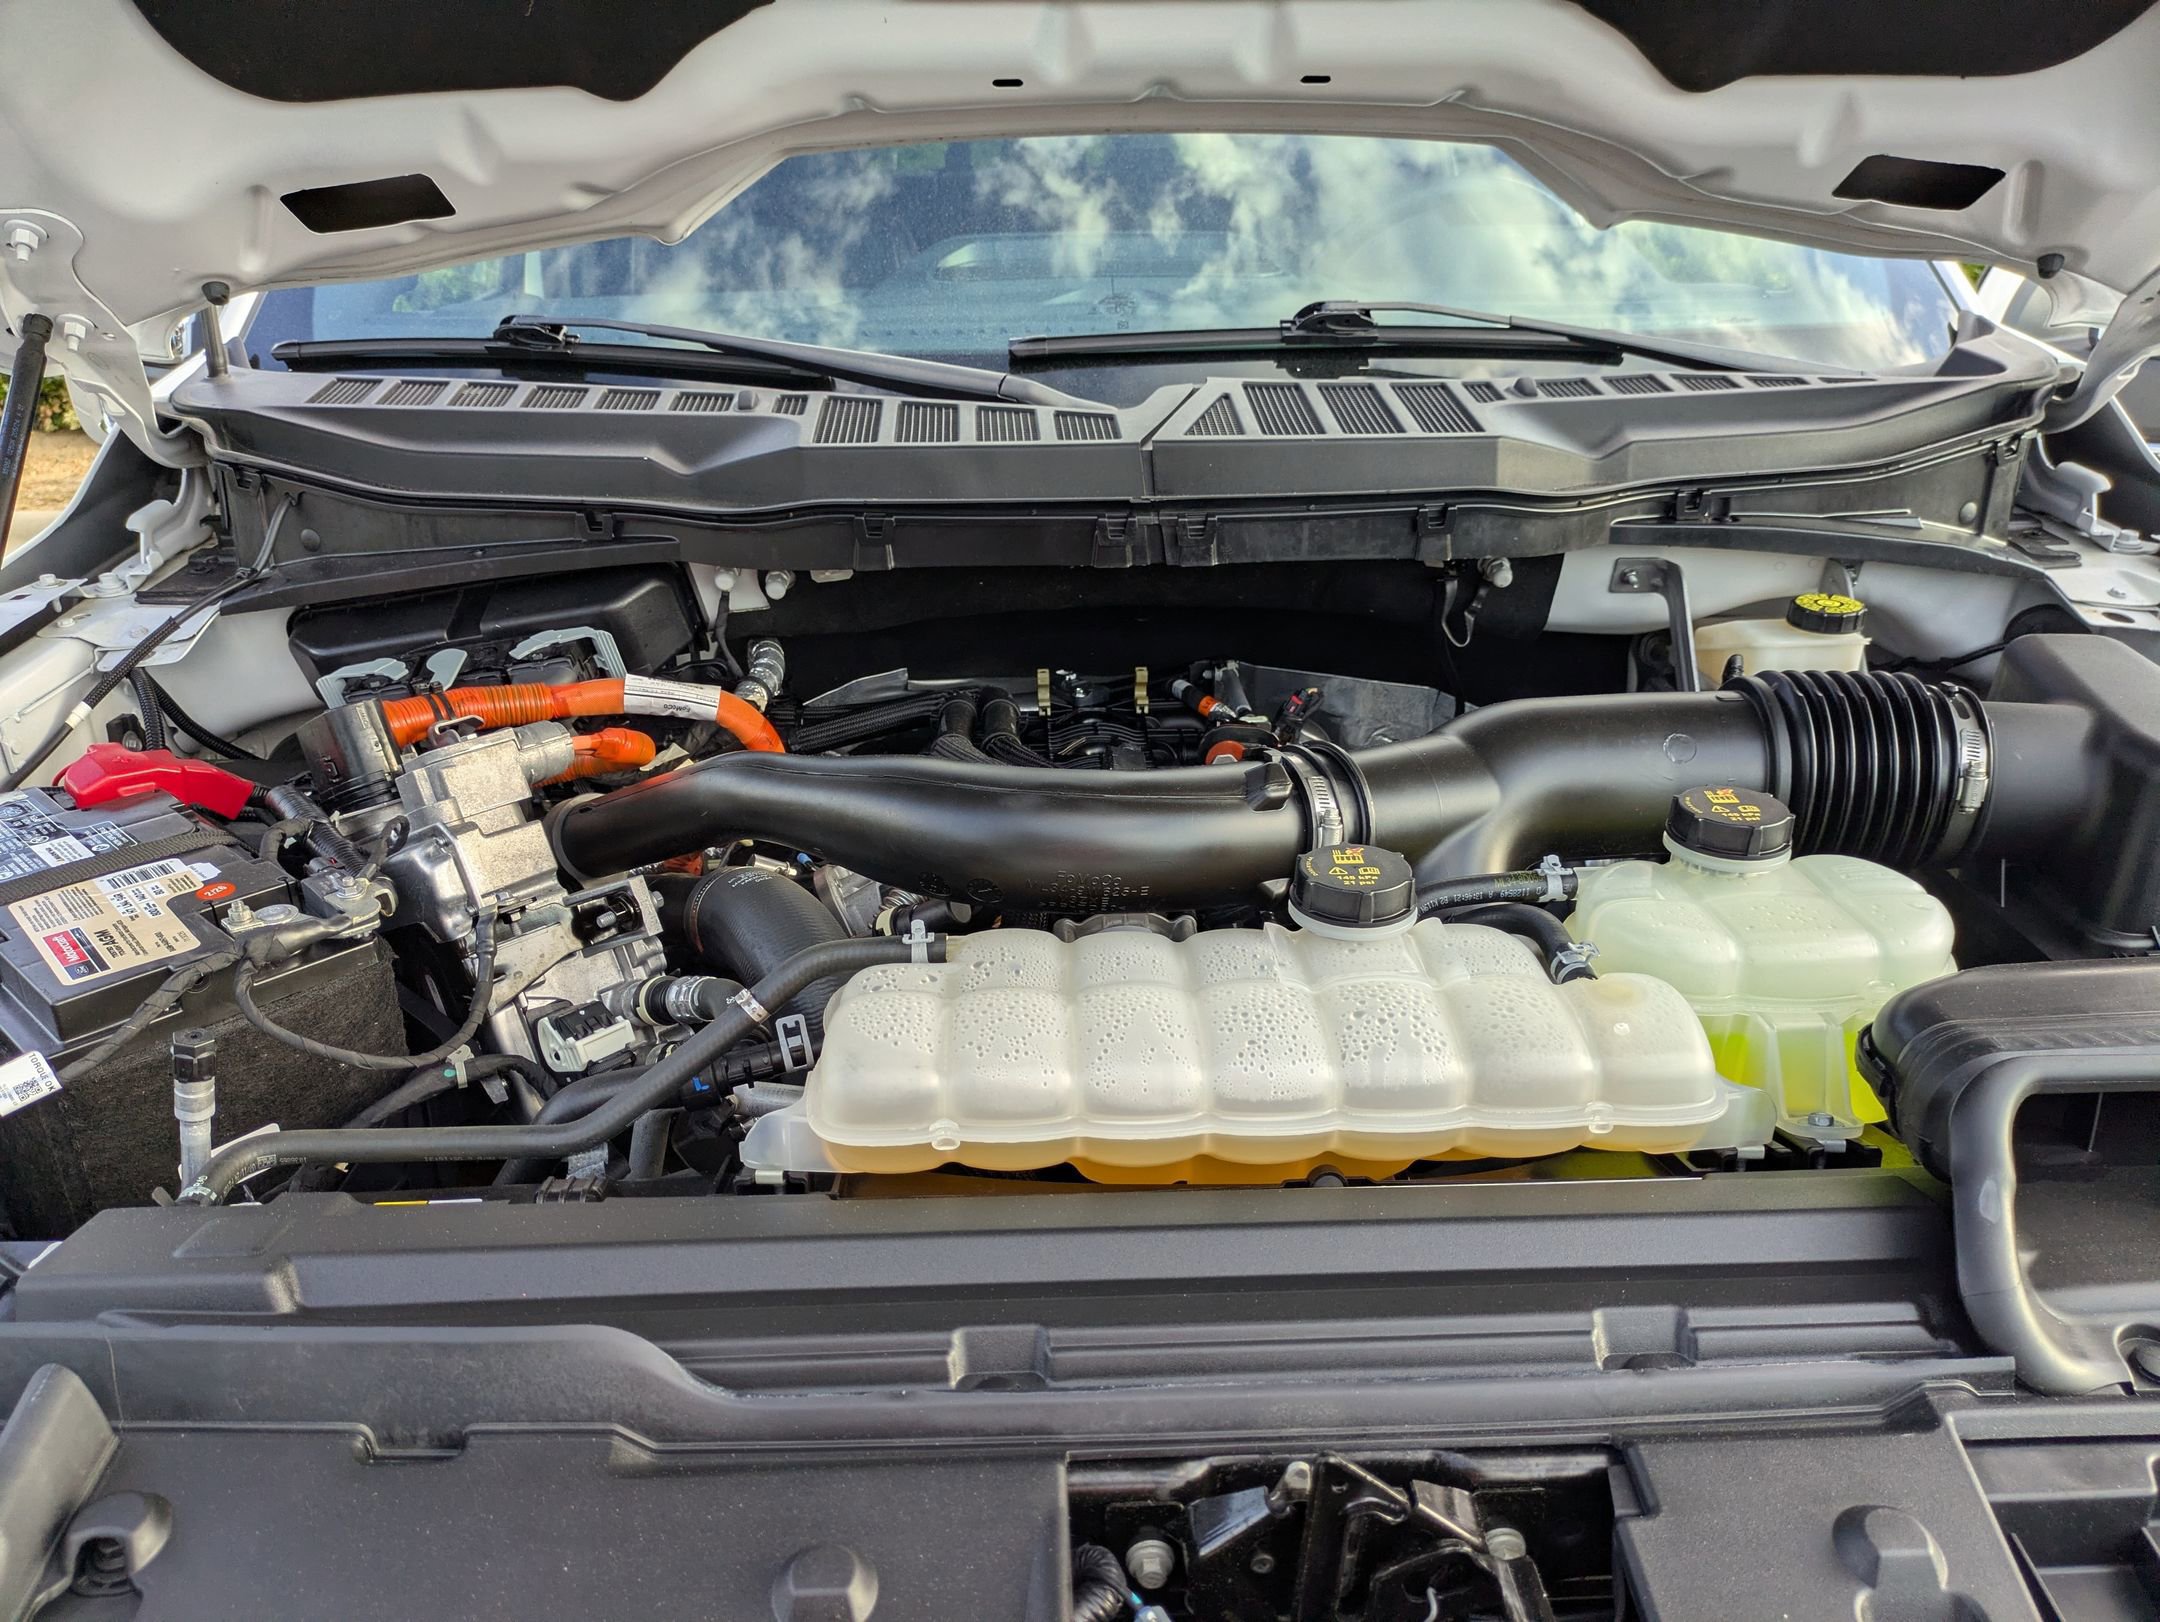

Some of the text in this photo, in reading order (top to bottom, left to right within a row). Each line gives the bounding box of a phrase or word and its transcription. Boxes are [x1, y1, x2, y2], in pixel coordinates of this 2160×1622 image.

[664, 704, 691, 713] FoMoCo
[51, 934, 80, 961] Motorcraft
[93, 928, 117, 946] AGM
[29, 1053, 56, 1092] TORQUE OK
